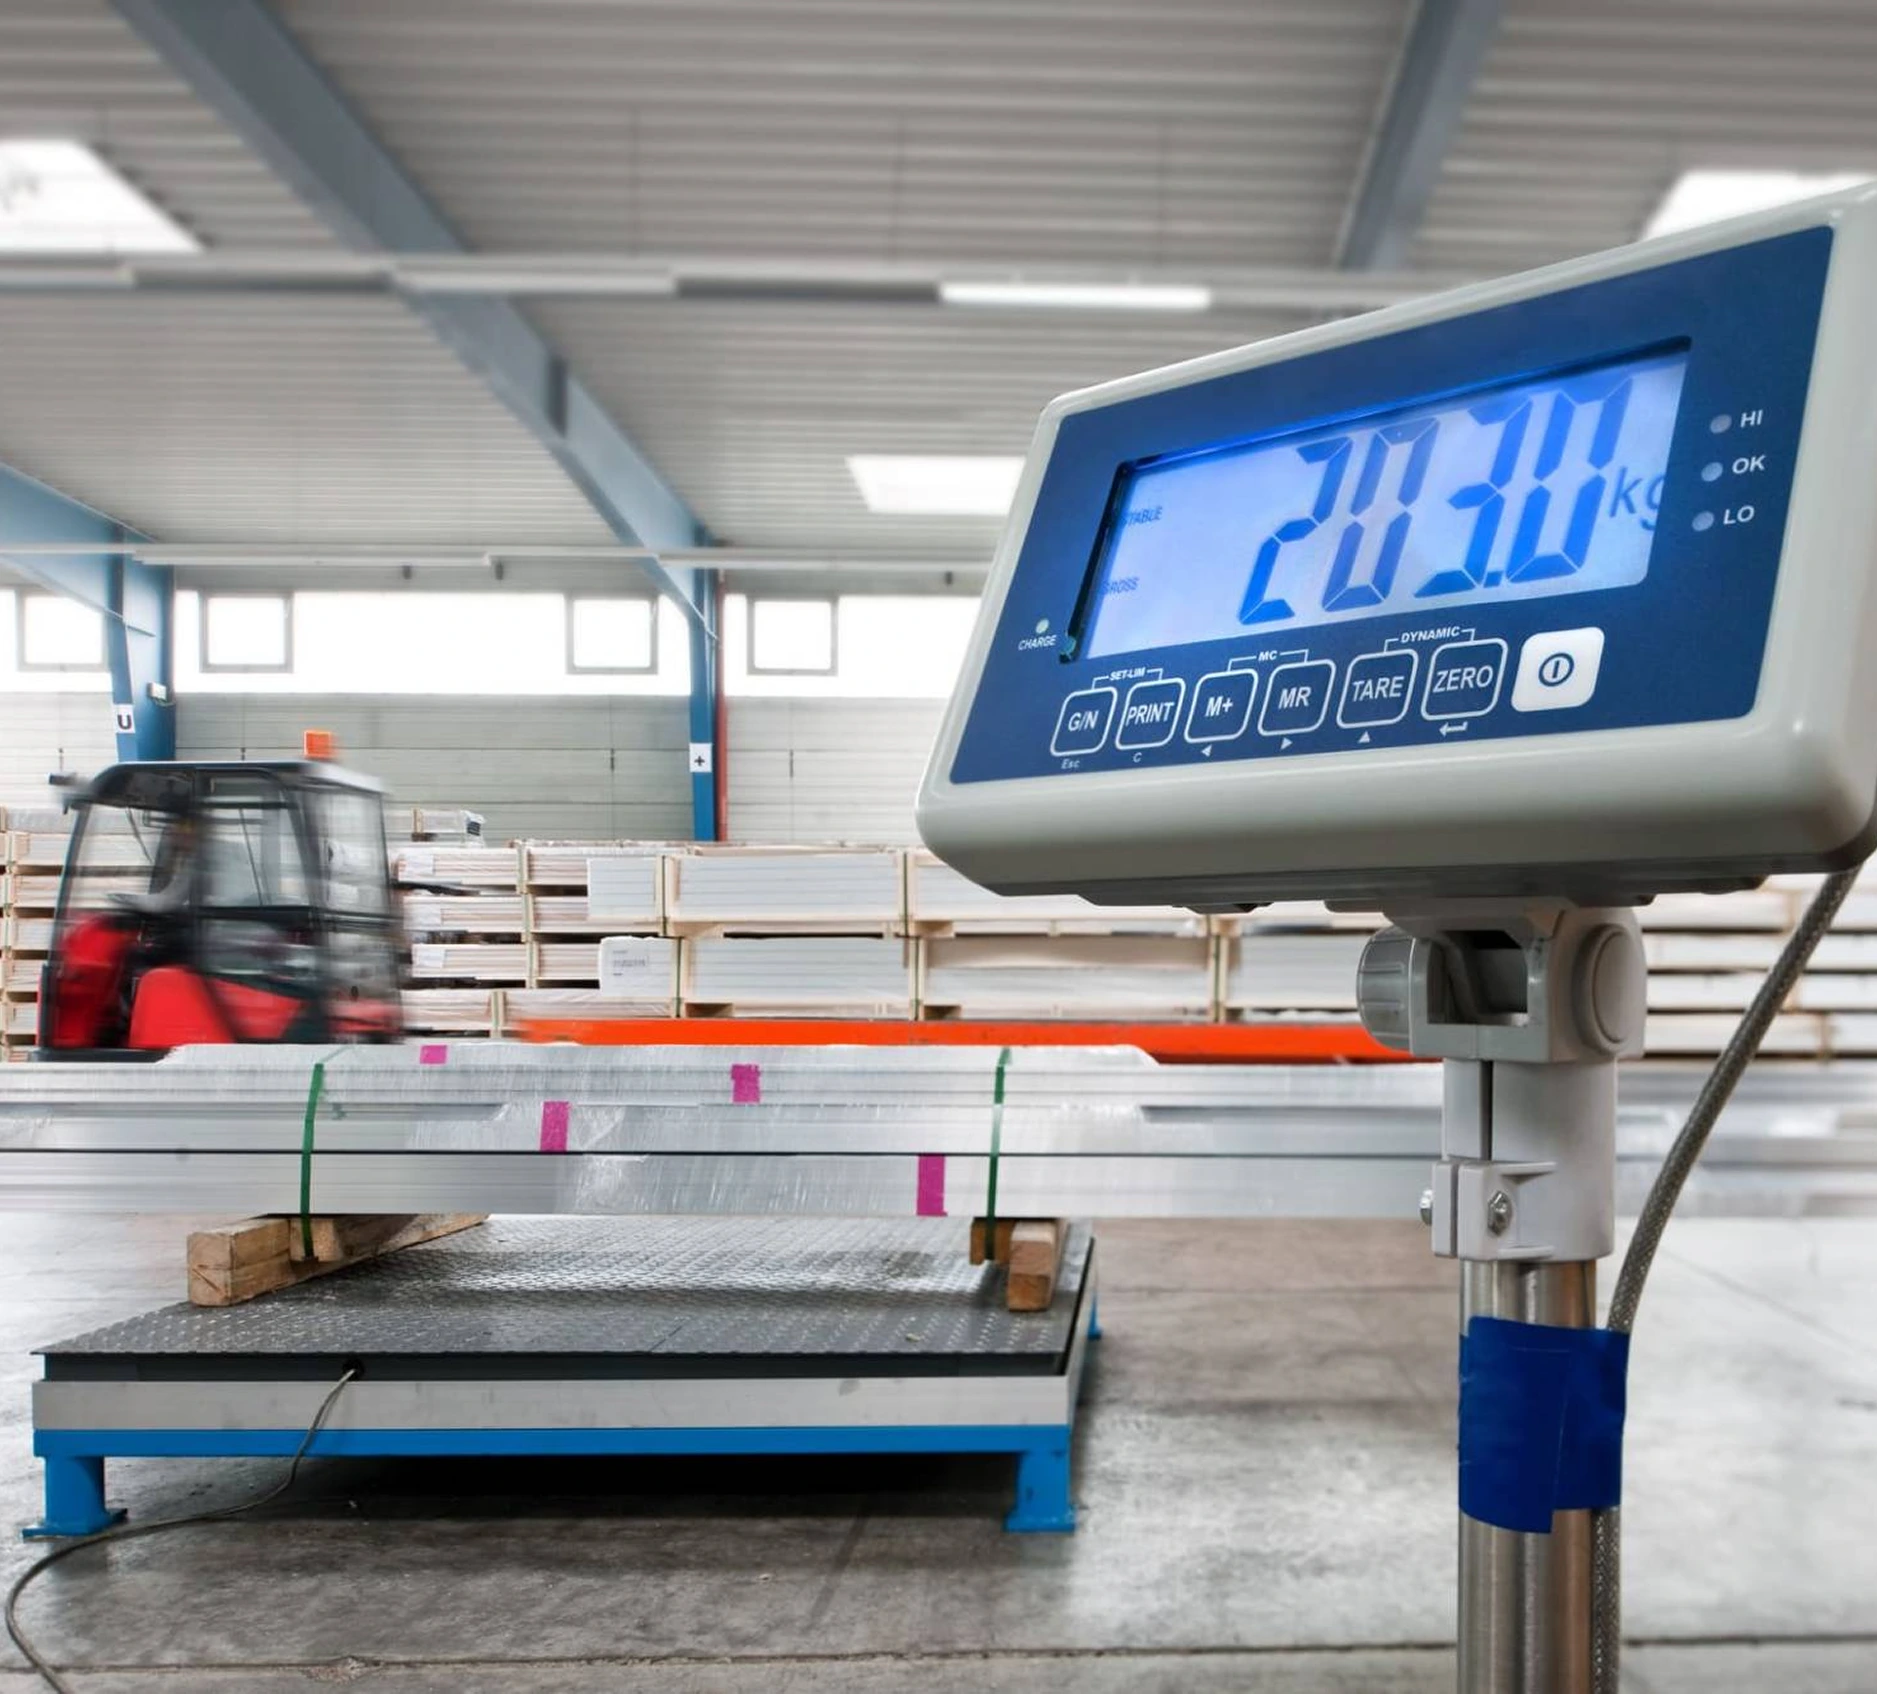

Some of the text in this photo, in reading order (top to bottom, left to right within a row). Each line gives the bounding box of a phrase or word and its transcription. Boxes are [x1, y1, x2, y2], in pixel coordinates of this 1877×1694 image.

[1740, 410, 1763, 428] HI
[1732, 455, 1766, 475] OK
[1723, 505, 1756, 525] LO
[1018, 634, 1057, 651] CHARGE
[1401, 626, 1461, 643] DYNAMIC
[1258, 650, 1278, 661] MC
[1110, 666, 1146, 681] SET-LIM
[1432, 665, 1494, 693] ZERO
[1278, 686, 1312, 709] MR
[1352, 676, 1404, 702] TARE
[1125, 702, 1175, 727] PRINT
[1204, 696, 1234, 717] M+
[117, 714, 132, 730] U
[1068, 710, 1099, 732] G/N
[1061, 758, 1081, 770] Esc
[1132, 752, 1143, 763] C
